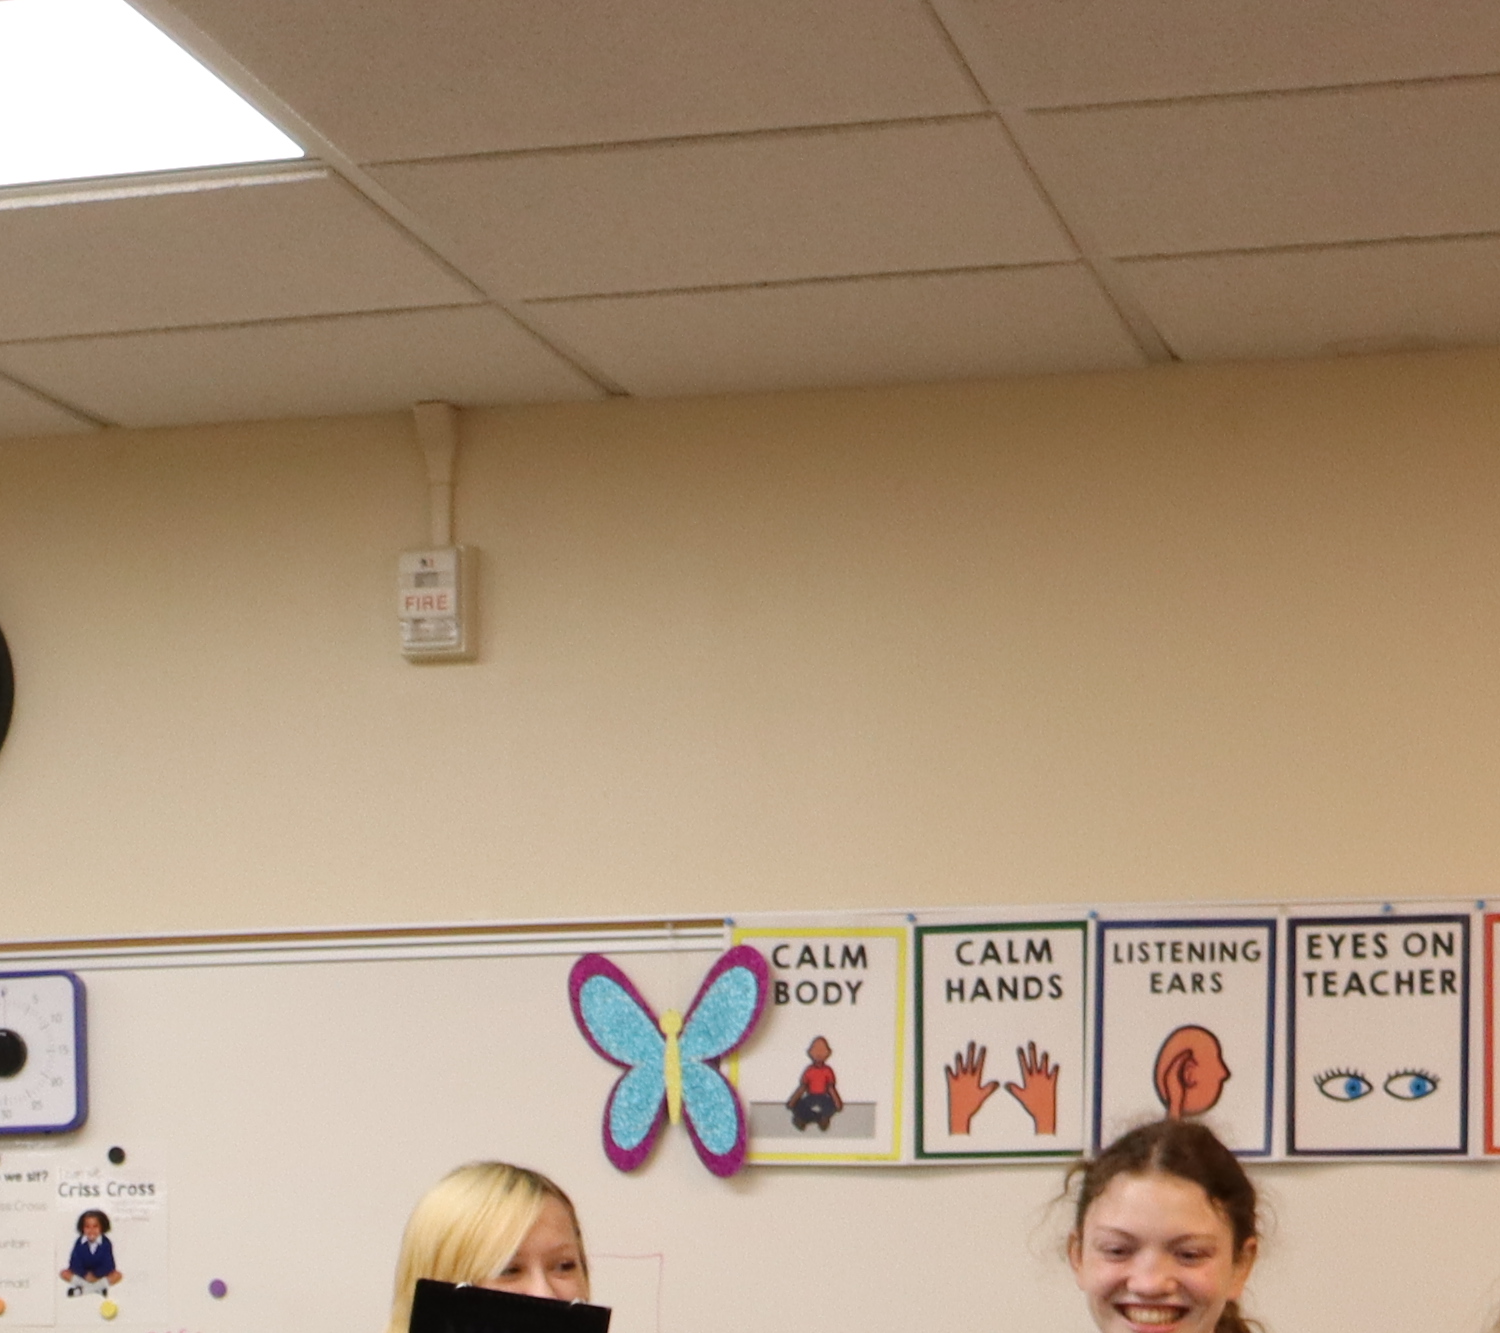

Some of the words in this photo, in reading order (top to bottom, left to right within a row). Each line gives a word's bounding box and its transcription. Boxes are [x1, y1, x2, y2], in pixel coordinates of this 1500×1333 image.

[405, 593, 448, 611] FIRE
[772, 944, 868, 970] CALM
[955, 938, 1053, 965] CALM
[1112, 940, 1262, 965] LISTENING
[1307, 932, 1388, 960] EYES
[1402, 930, 1455, 958] ON
[774, 980, 864, 1005] BODY
[946, 975, 1064, 1001] HANDS
[1150, 972, 1223, 995] EARS
[1303, 970, 1457, 997] TEACHER
[4, 1174, 22, 1182] we
[26, 1171, 48, 1182] sit?
[58, 1183, 100, 1198] Criss
[107, 1182, 155, 1197] Cross
